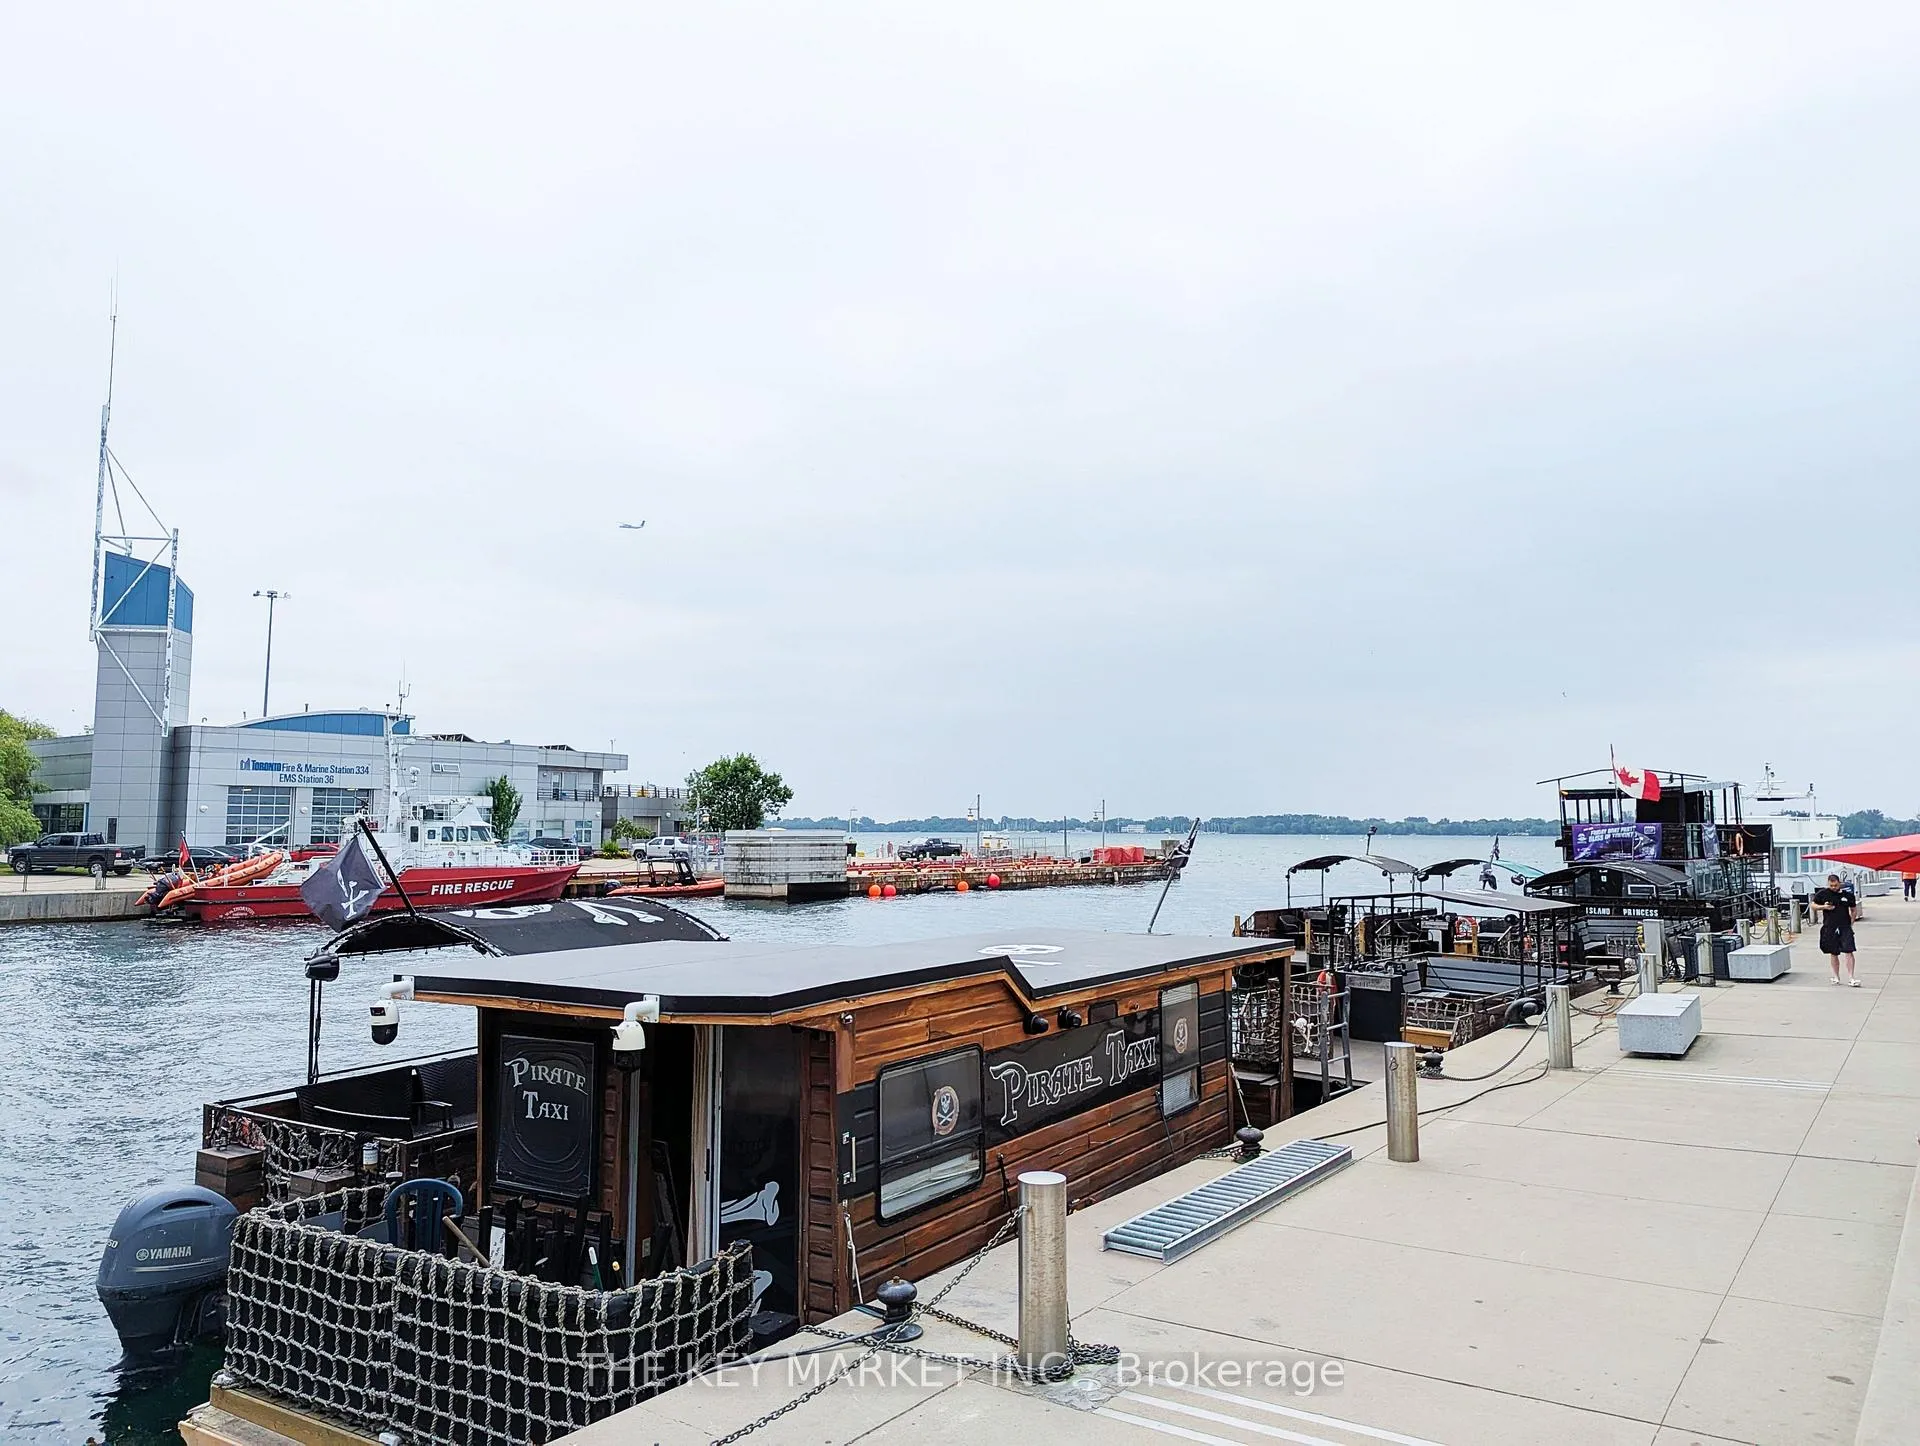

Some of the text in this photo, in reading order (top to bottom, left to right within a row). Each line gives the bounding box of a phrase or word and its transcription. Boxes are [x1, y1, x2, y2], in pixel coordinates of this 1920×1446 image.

[251, 760, 369, 775] TORONTO Fire & Marine Station 334
[280, 774, 334, 784] EMS Station 36
[431, 880, 514, 895] FIRE RESCUE
[1586, 907, 1659, 917] ISLAND PRINCESS
[504, 1058, 588, 1095] PIRATE
[990, 1029, 1157, 1126] PIRATE TAXI
[523, 1091, 569, 1120] TAXI
[150, 1246, 192, 1259] YAMAHA
